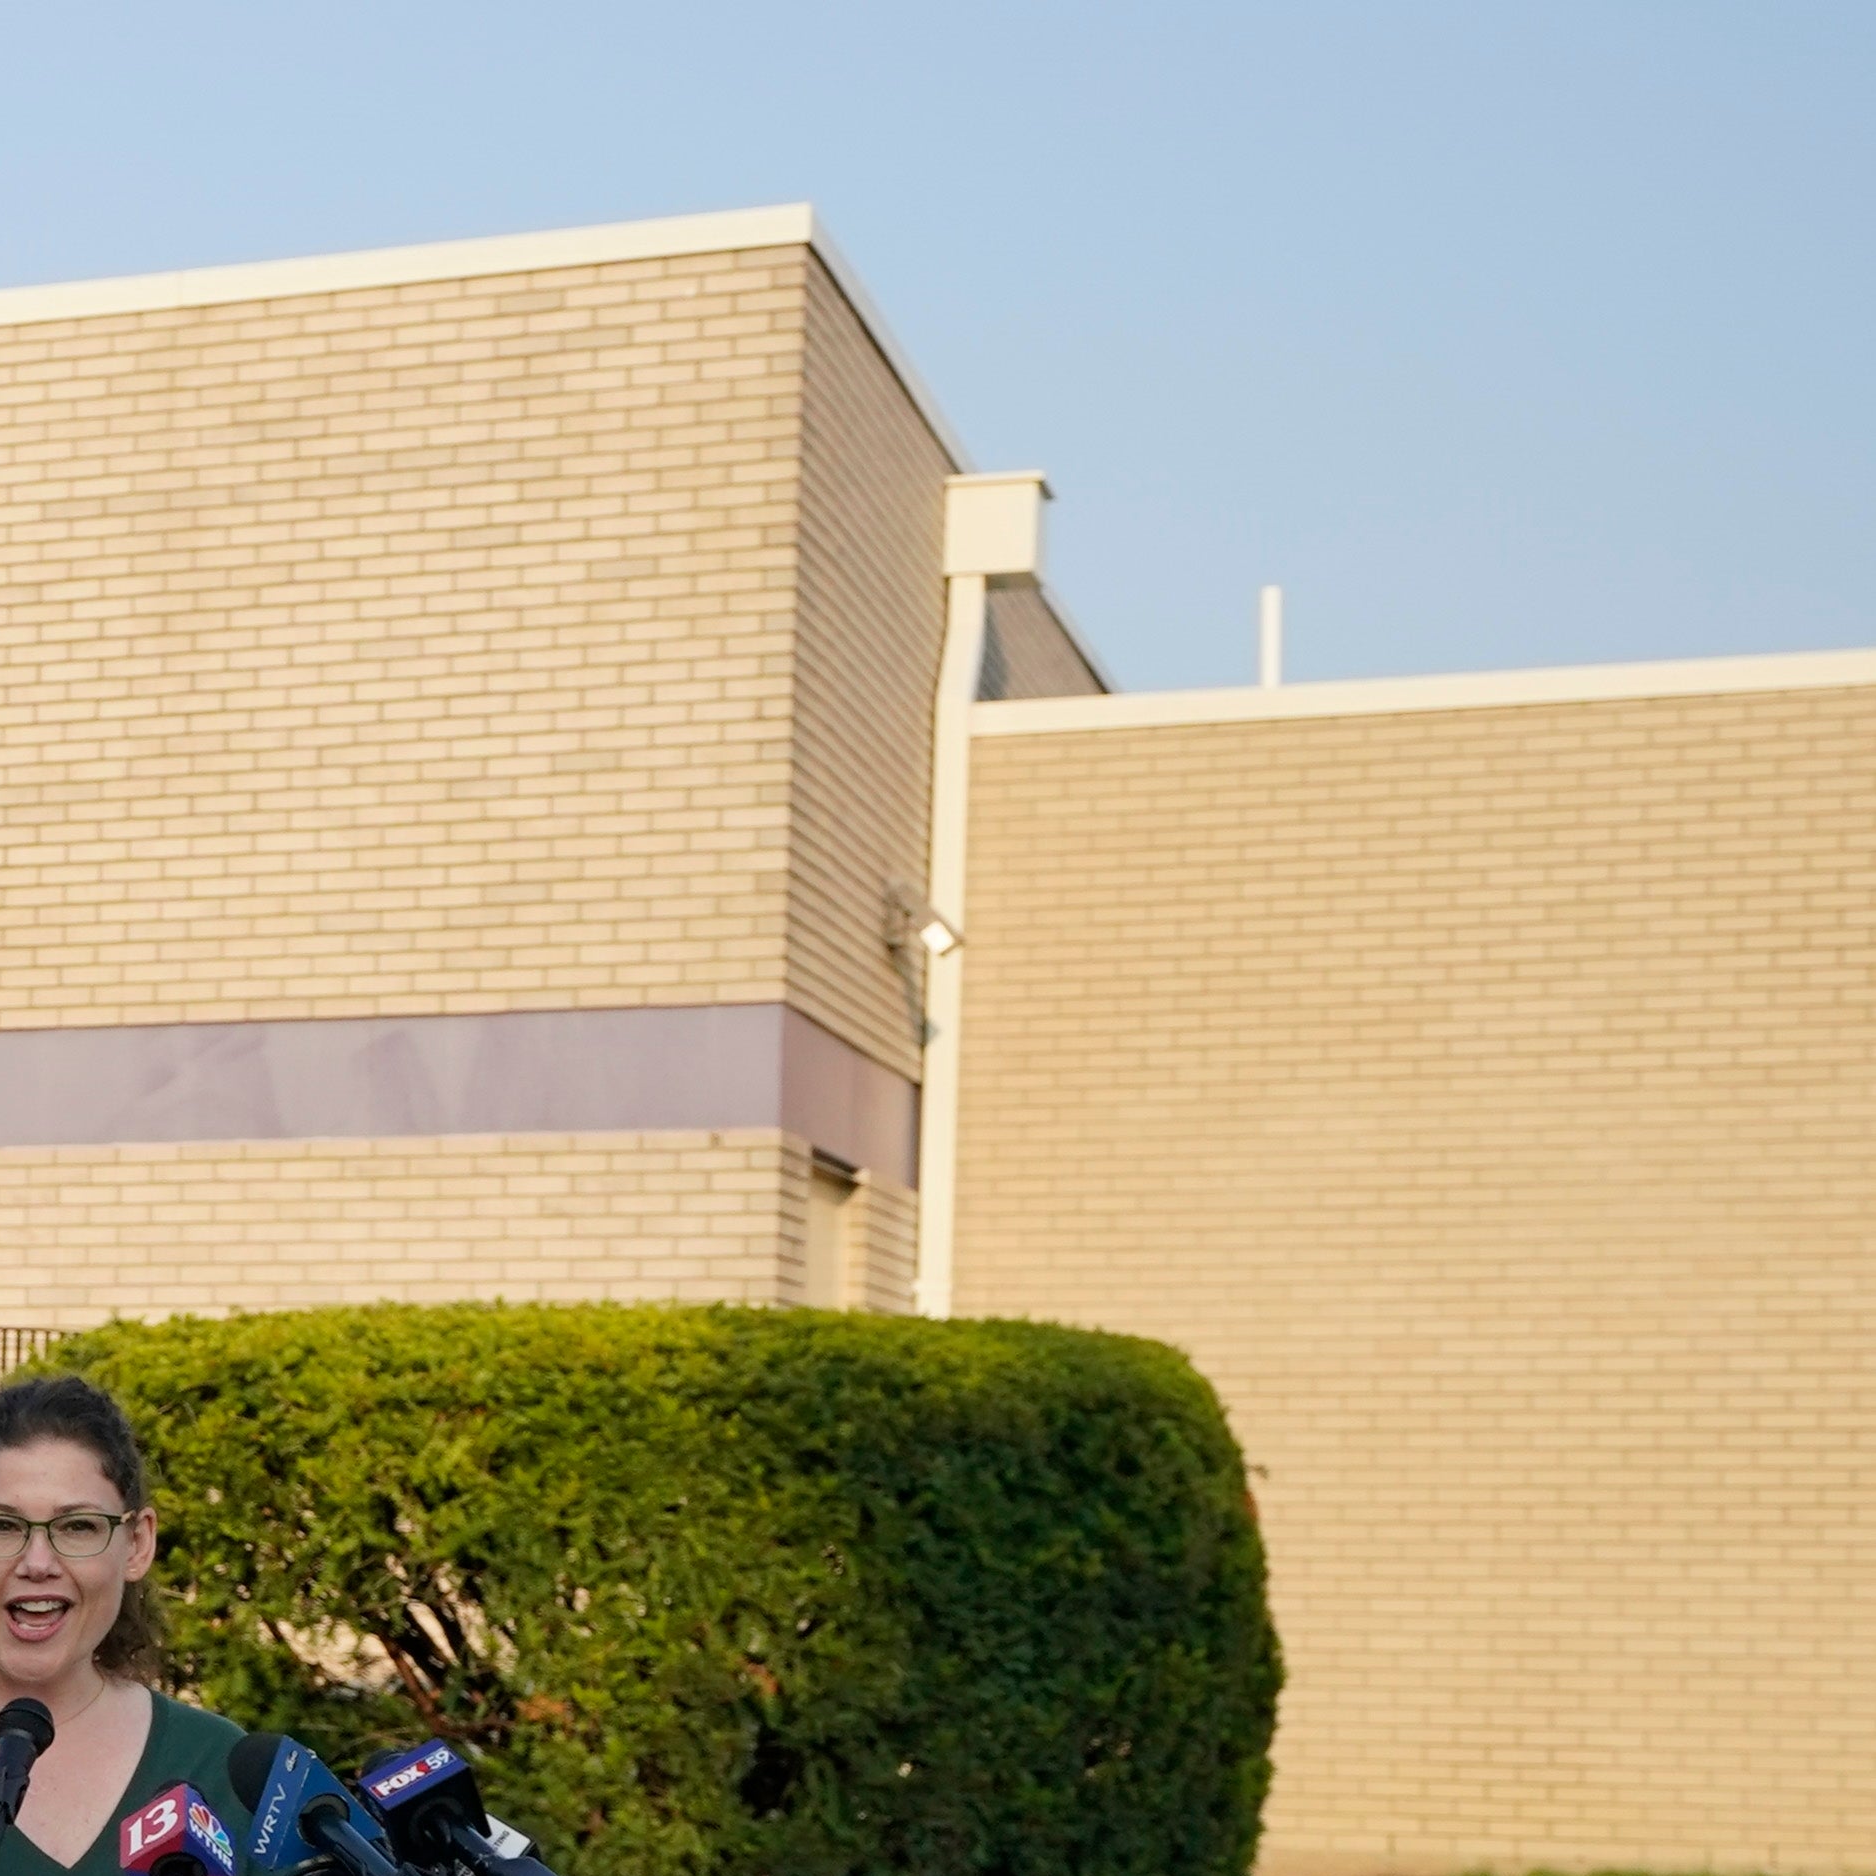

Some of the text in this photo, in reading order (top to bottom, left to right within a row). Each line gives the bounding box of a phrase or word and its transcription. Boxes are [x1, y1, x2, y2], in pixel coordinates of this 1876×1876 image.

[374, 1748, 451, 1797] FOX 59
[127, 1798, 179, 1856] 13
[188, 1817, 233, 1871] WTHR
[253, 1782, 287, 1855] WRTV
